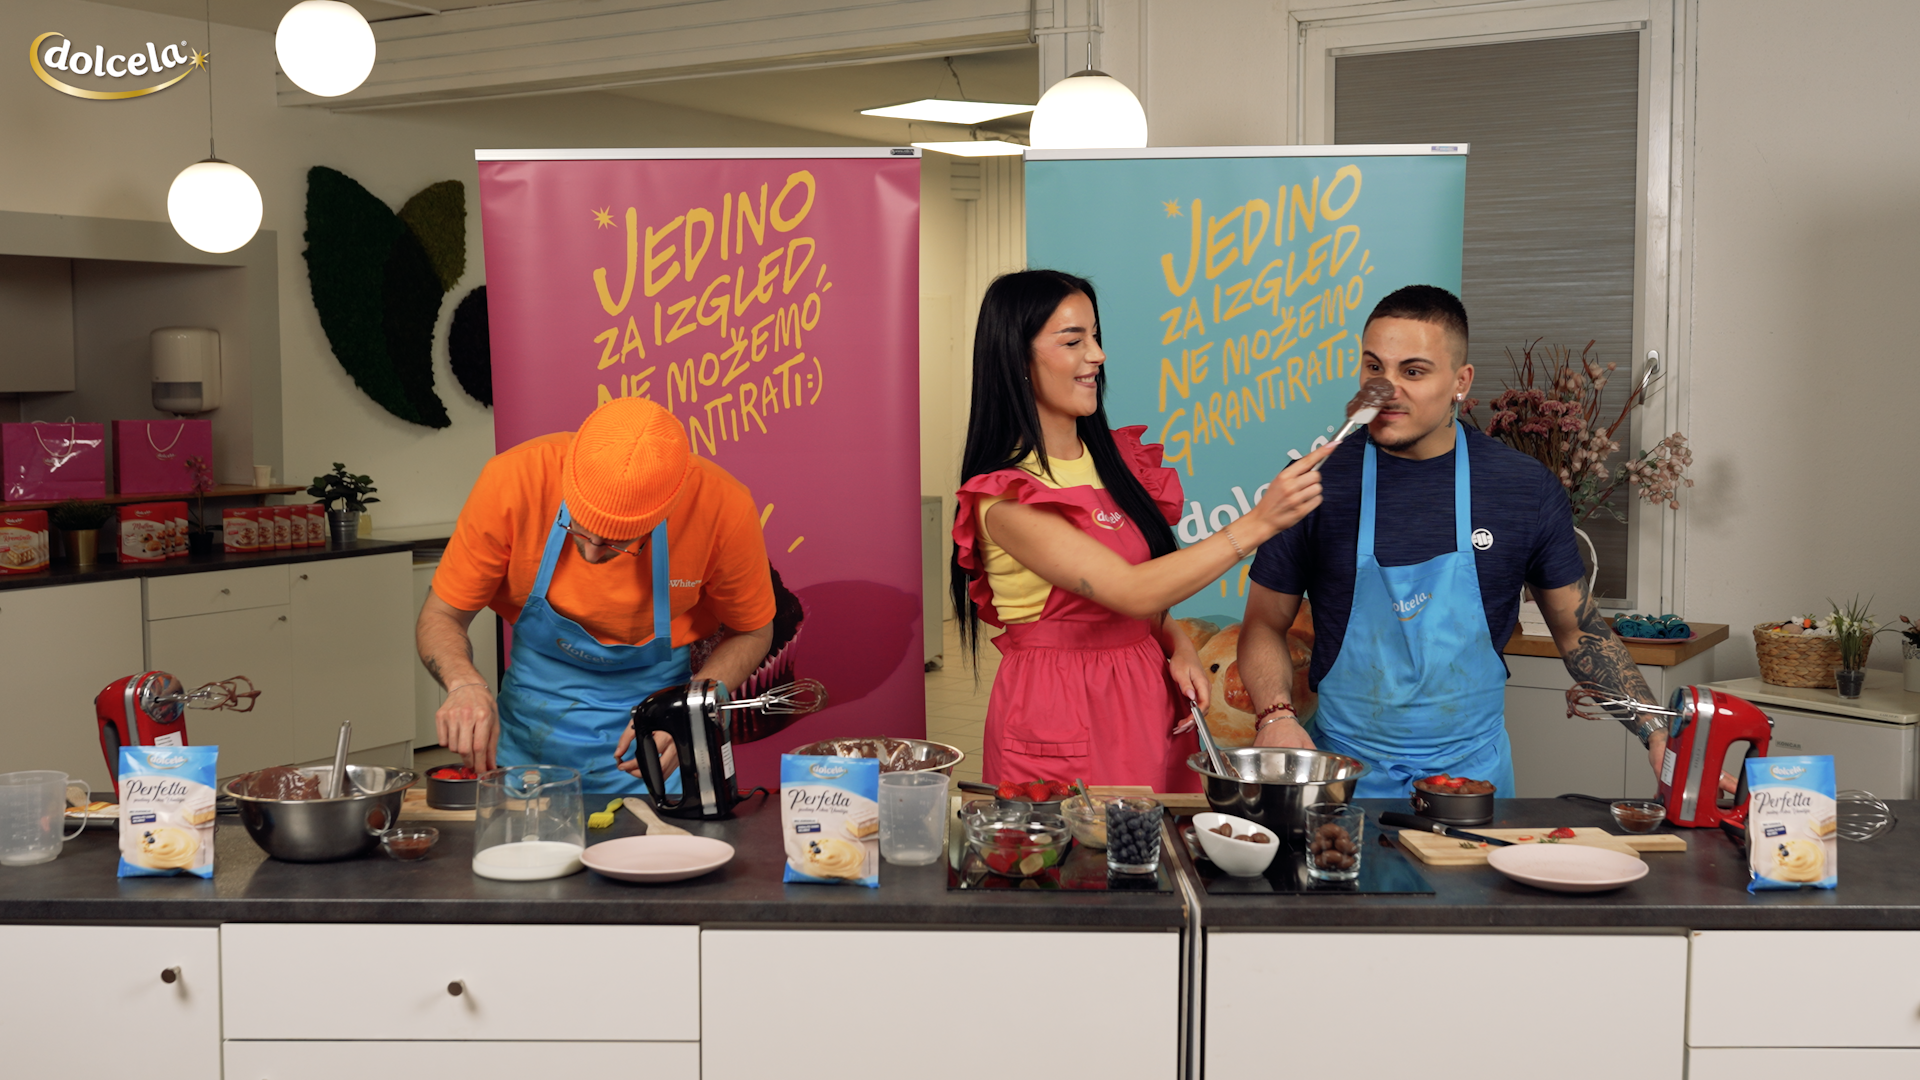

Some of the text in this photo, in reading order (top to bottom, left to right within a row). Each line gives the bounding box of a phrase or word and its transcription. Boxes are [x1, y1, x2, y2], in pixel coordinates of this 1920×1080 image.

[593, 170, 816, 316] JEDINO
[1161, 164, 1362, 297] JEDINO
[1159, 224, 1360, 346] ZA IZGLED
[593, 236, 816, 370] ZA IZGLED
[667, 292, 821, 414] MOŽEMO
[1159, 274, 1364, 413] NE MOŽEMO
[1392, 591, 1428, 613] olcela
[560, 640, 615, 665] dolcela
[150, 755, 185, 765] dolcela
[812, 764, 844, 775] dolcela
[126, 779, 188, 801] Perfetta
[788, 788, 852, 811] Perfetta
[1754, 791, 1811, 814] Perfetta
